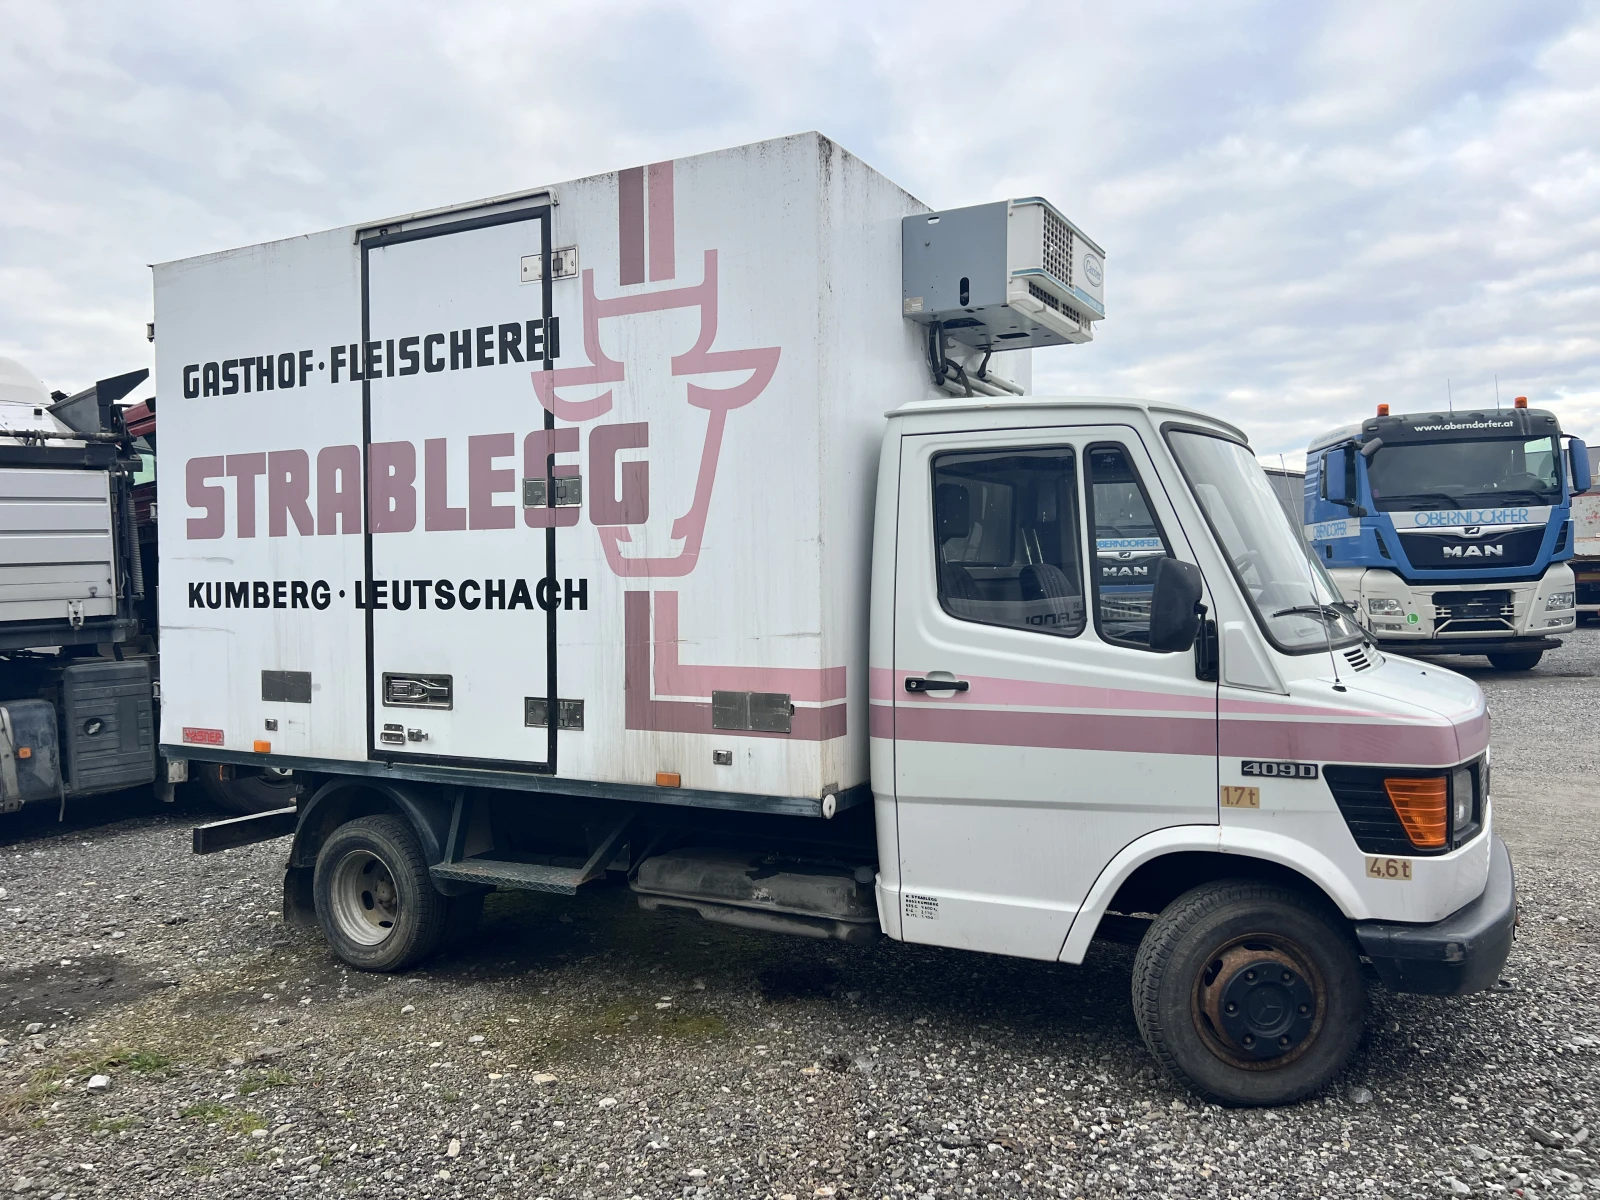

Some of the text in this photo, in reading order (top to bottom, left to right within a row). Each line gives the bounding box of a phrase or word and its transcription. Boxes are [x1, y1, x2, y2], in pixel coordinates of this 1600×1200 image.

[1414, 420, 1513, 432] www.oberndorfer.at
[186, 422, 649, 540] STRABLEGG
[1415, 508, 1529, 526] OBERNDORFER
[1442, 544, 1503, 558] MAN
[1102, 566, 1148, 576] MAN
[188, 580, 331, 610] KUMBERG
[355, 576, 588, 611] LEUTSCHACH
